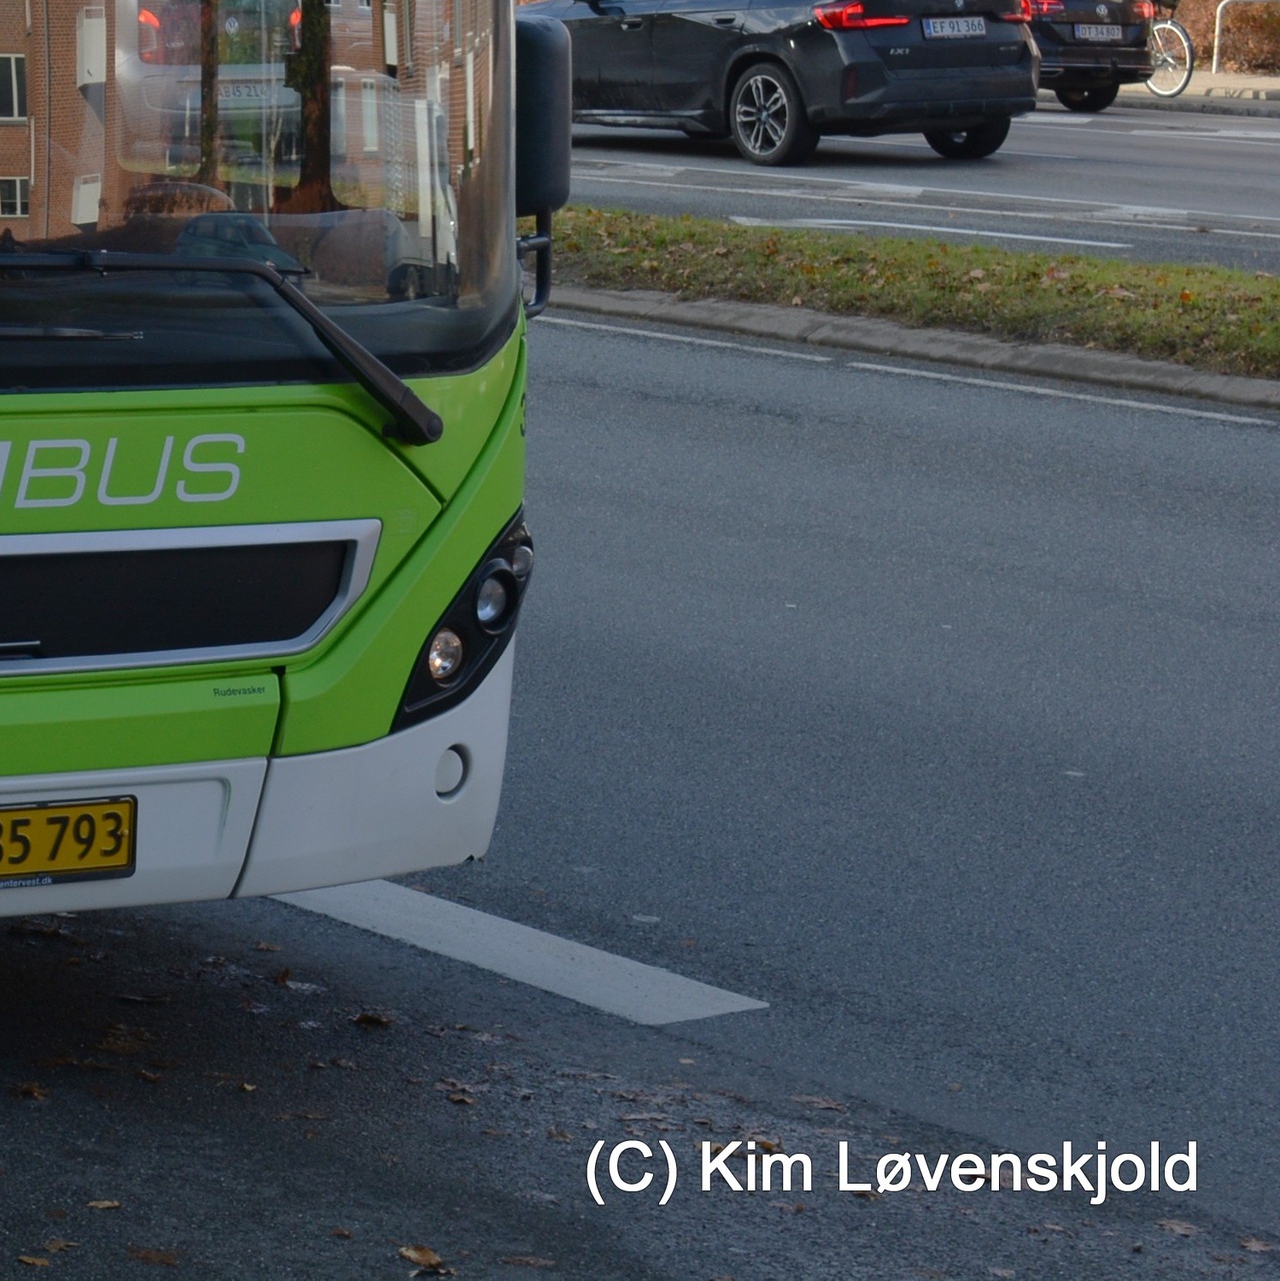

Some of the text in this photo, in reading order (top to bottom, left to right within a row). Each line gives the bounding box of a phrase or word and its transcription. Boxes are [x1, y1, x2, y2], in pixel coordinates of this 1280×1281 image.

[932, 19, 984, 34] EF 91 366
[213, 686, 266, 697] Rudevasker
[46, 811, 124, 862] 793
